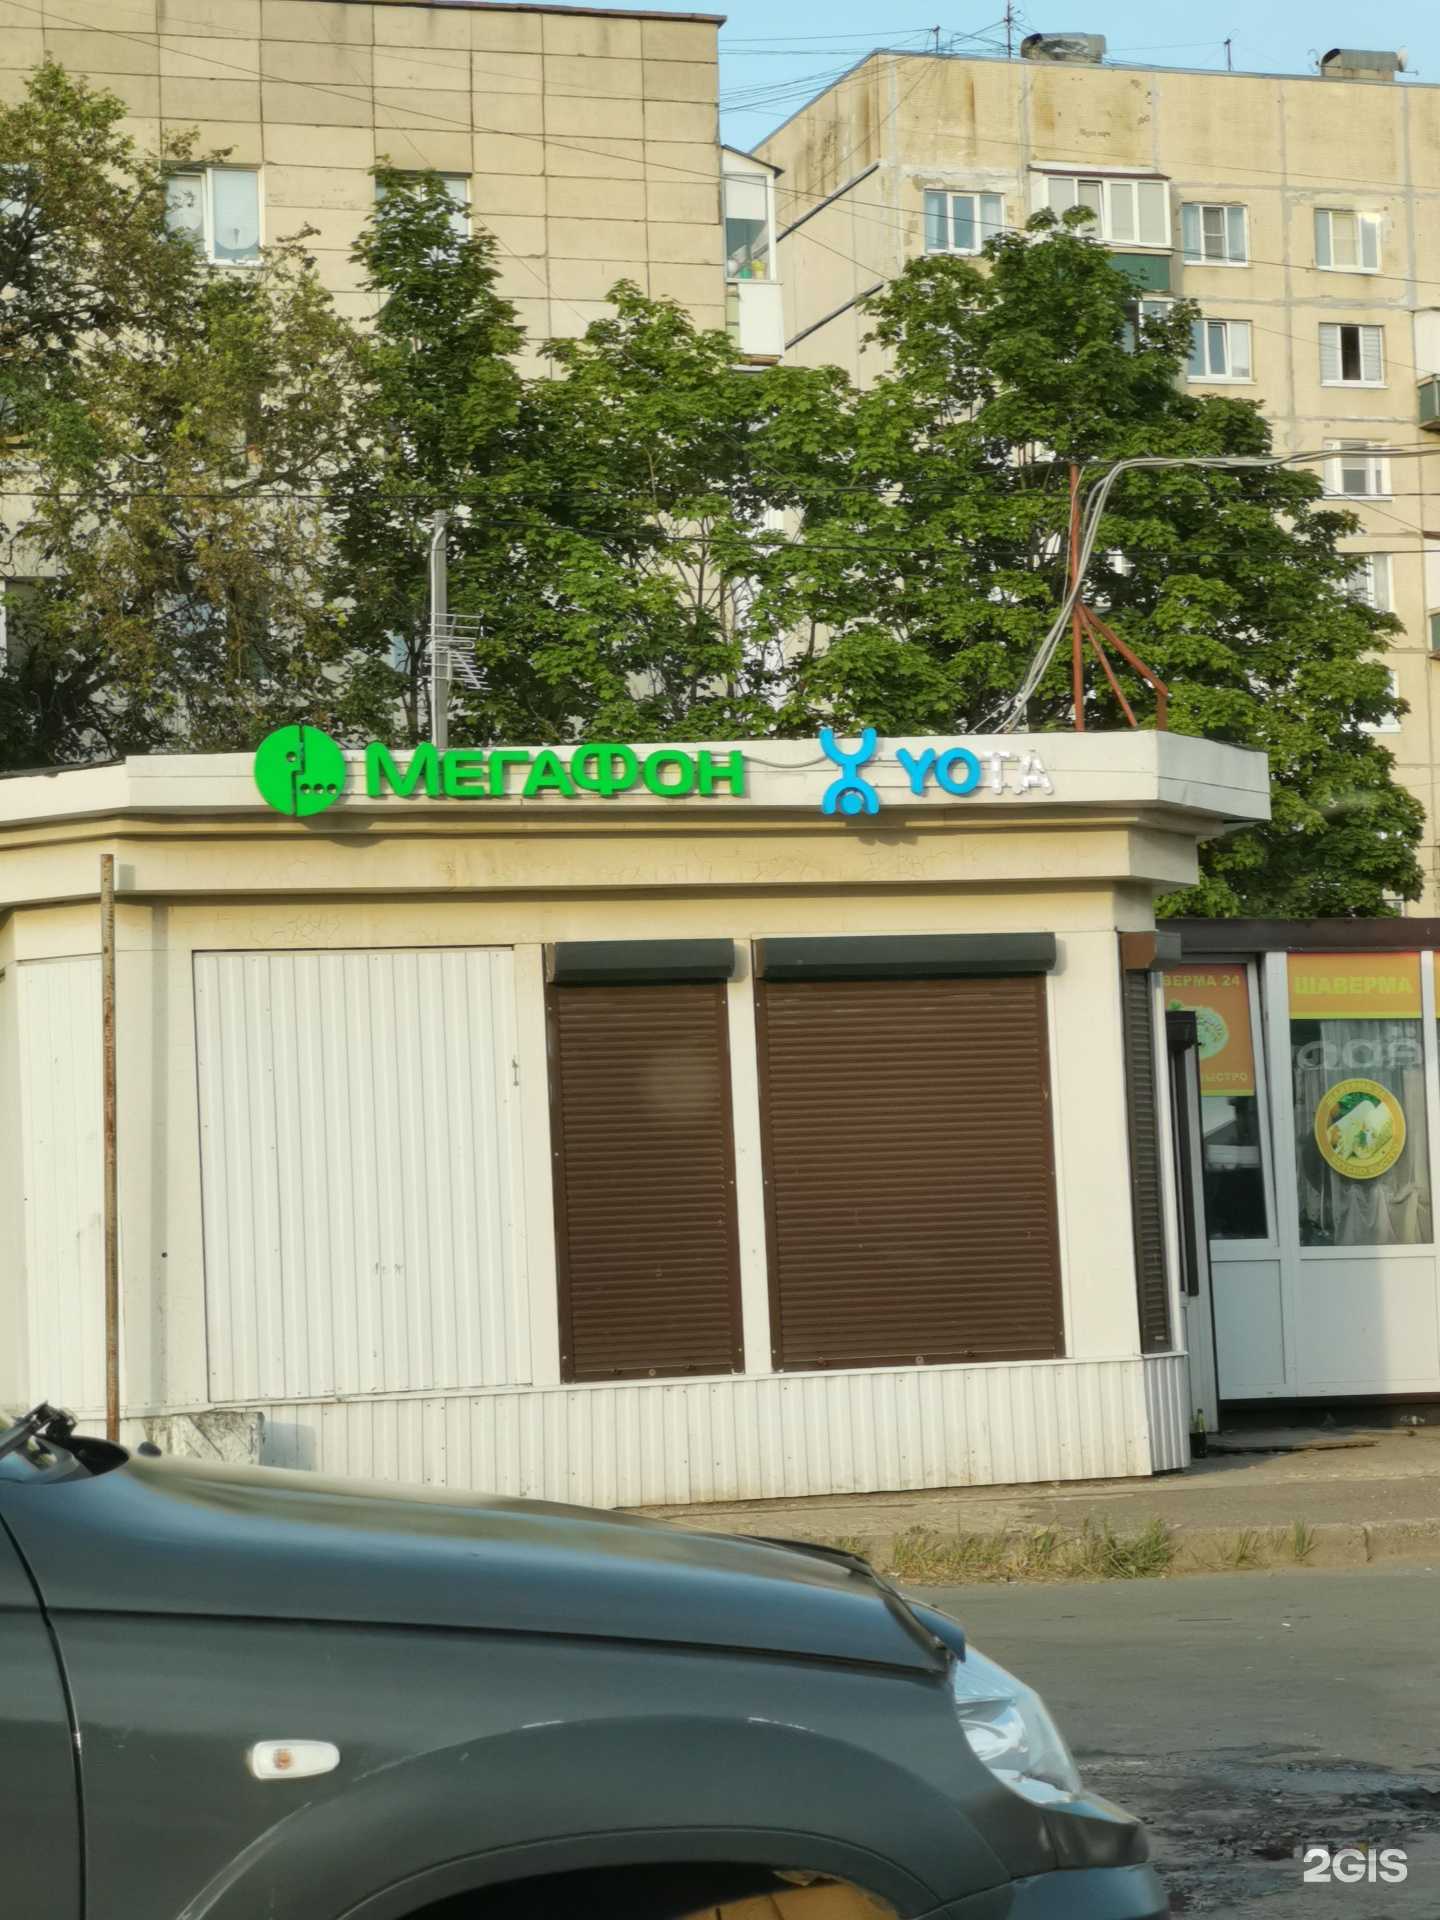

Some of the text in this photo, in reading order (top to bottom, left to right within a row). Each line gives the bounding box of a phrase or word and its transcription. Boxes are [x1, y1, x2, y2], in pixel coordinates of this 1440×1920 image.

[365, 741, 746, 799] МЕГАФОН
[895, 747, 1054, 797] YOTA
[1221, 975, 1240, 987] 24
[1294, 975, 1413, 994] ШАВЕРМА
